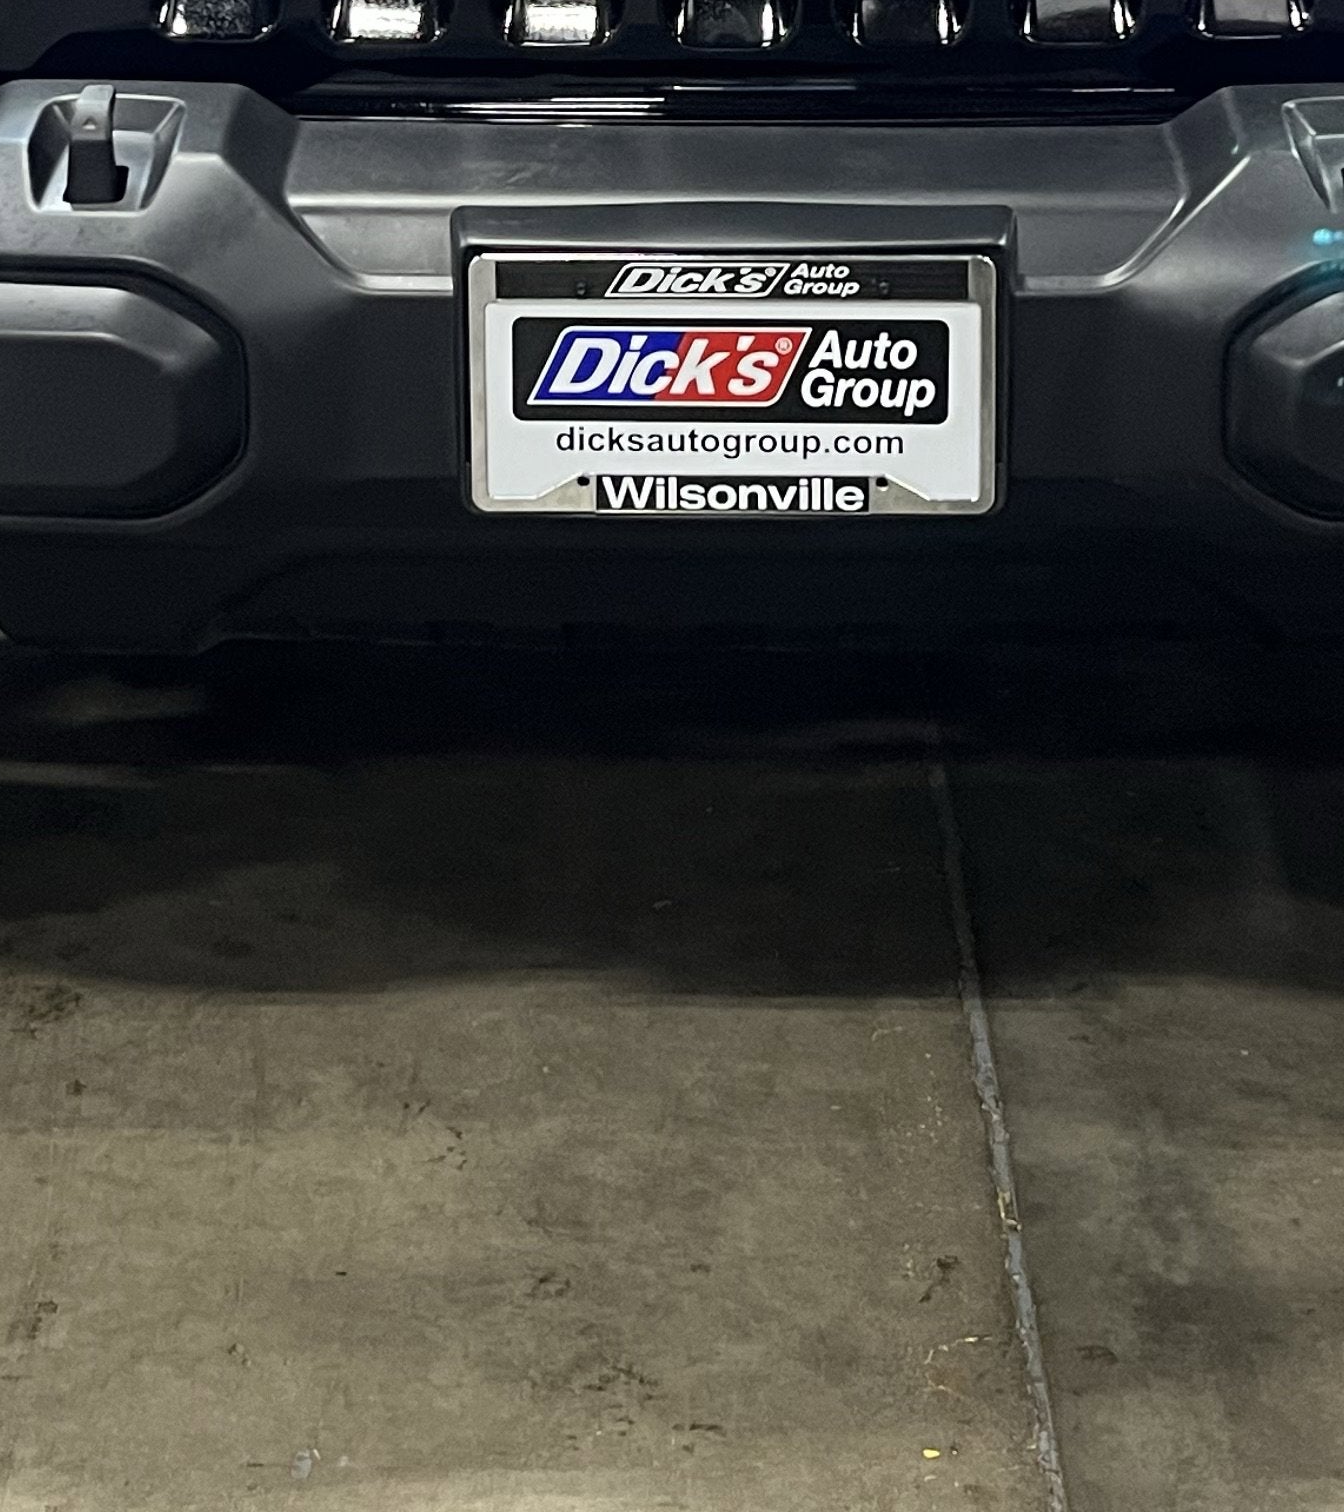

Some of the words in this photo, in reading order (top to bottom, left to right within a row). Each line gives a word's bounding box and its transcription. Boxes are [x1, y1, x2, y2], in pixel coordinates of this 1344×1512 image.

[790, 262, 851, 279] Auto
[783, 280, 861, 298] Group
[808, 330, 918, 371] Auto
[801, 370, 936, 416] Group
[556, 426, 905, 460] dicksautogroup.com
[601, 475, 866, 512] Wilsonville
